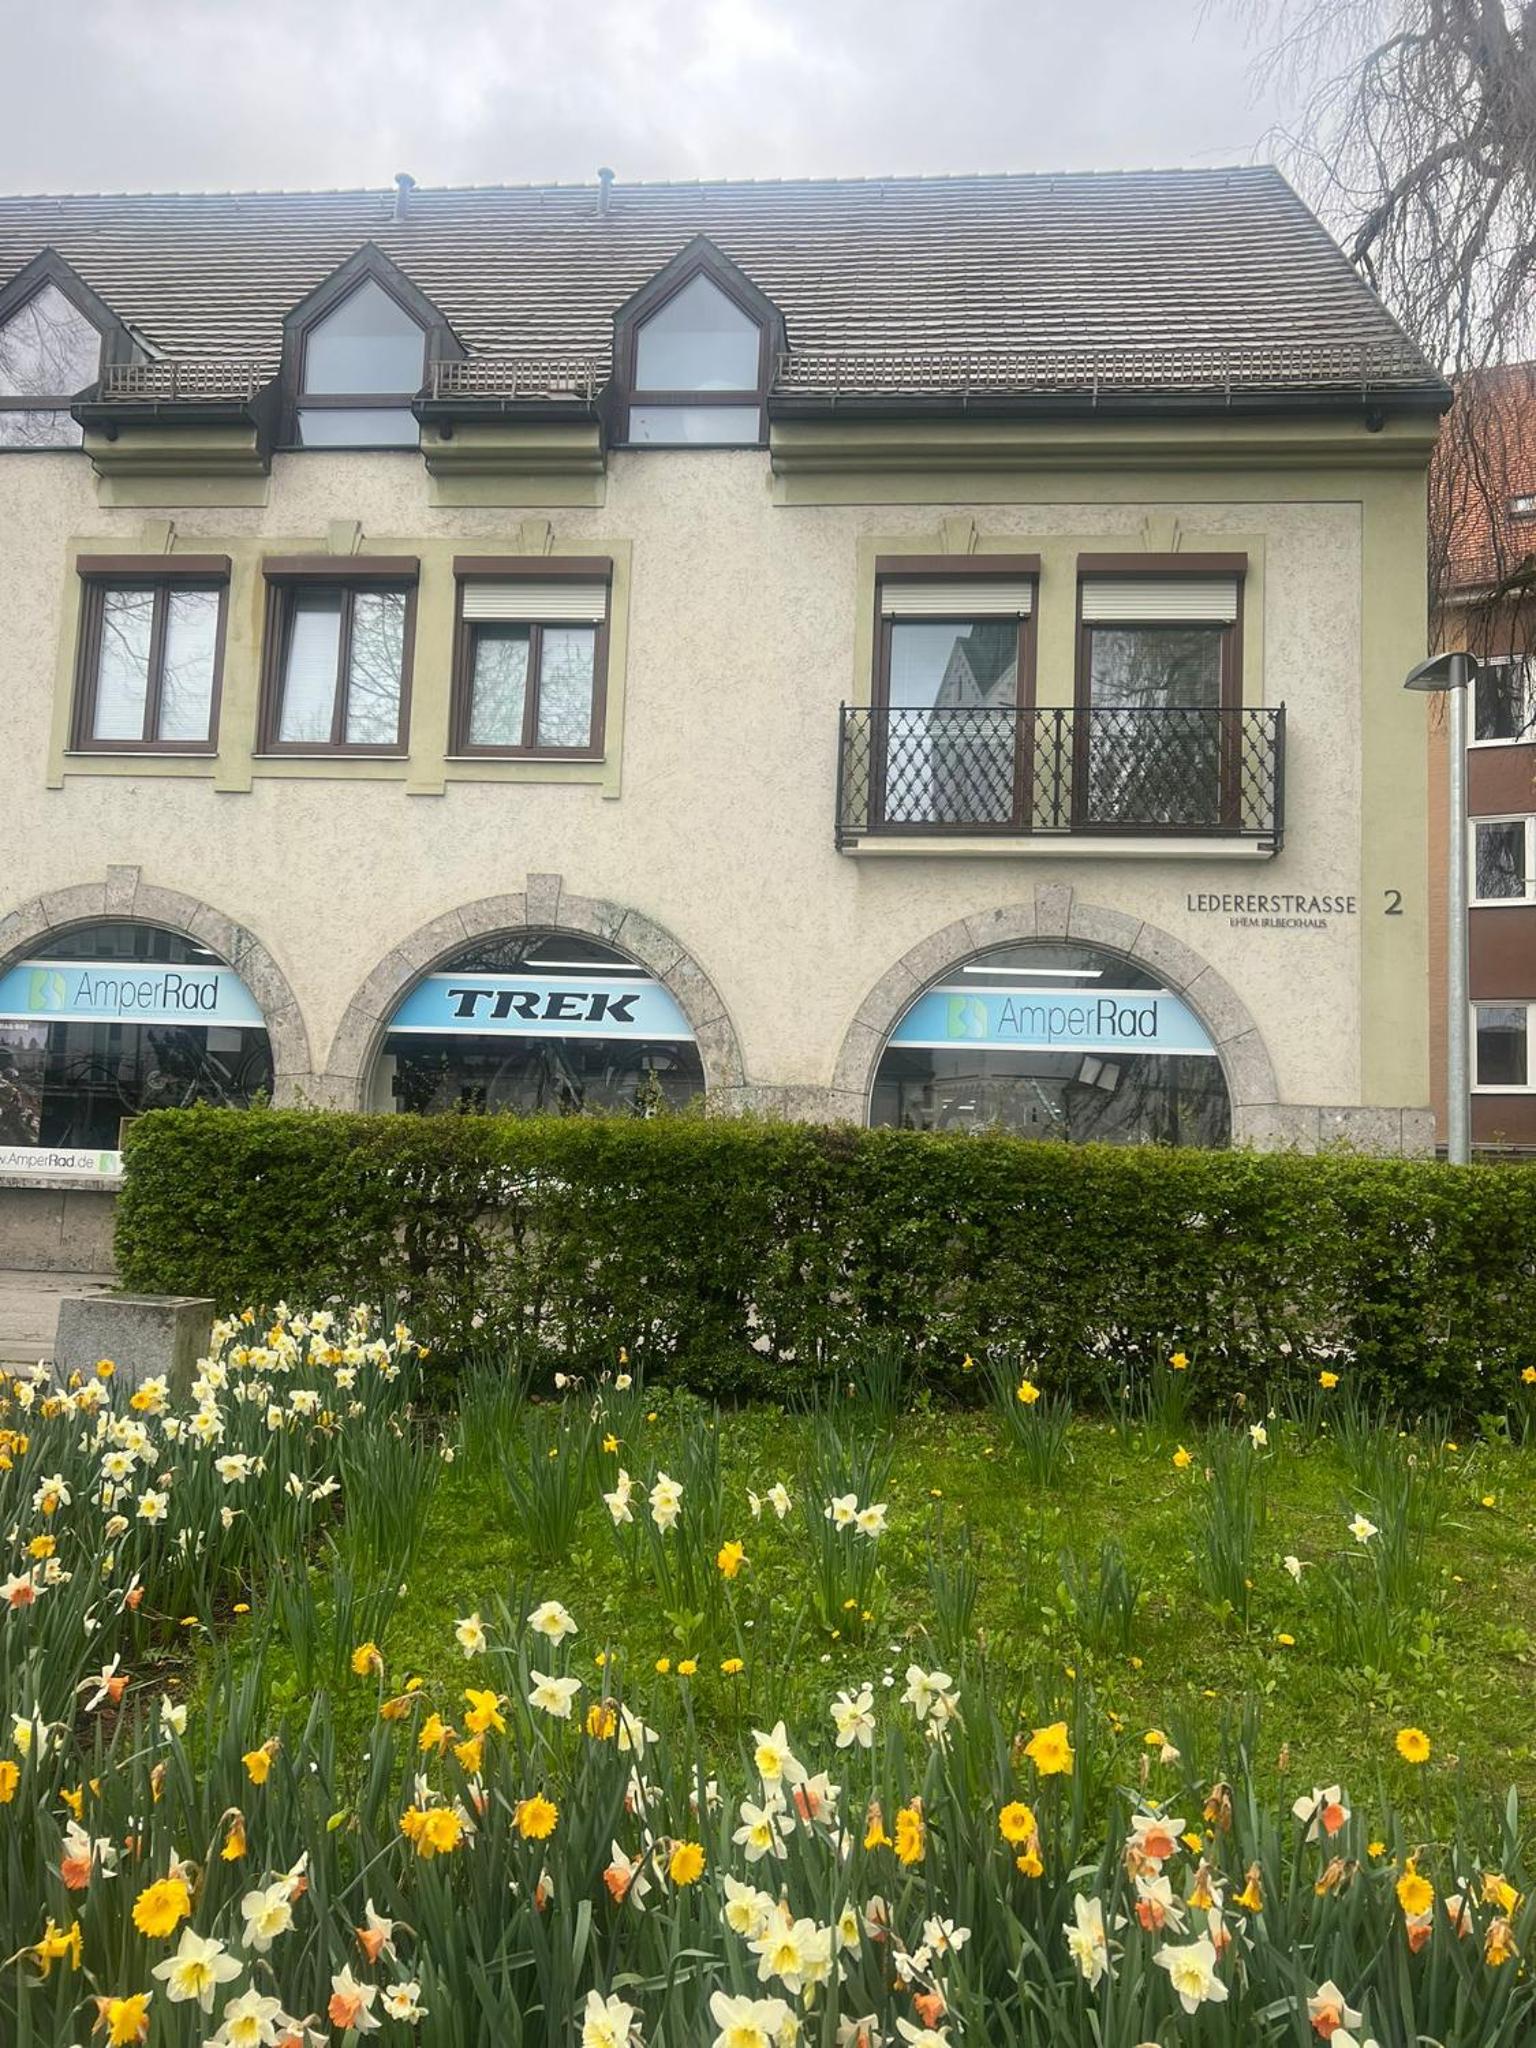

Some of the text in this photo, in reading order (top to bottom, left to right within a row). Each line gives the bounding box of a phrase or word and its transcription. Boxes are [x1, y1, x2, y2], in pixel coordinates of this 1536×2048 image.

[1187, 889, 1403, 915] LEDERERSTRASSE 2
[74, 971, 219, 1016] AmperRad
[447, 989, 641, 1022] TREK
[998, 998, 1158, 1043] AmperRad
